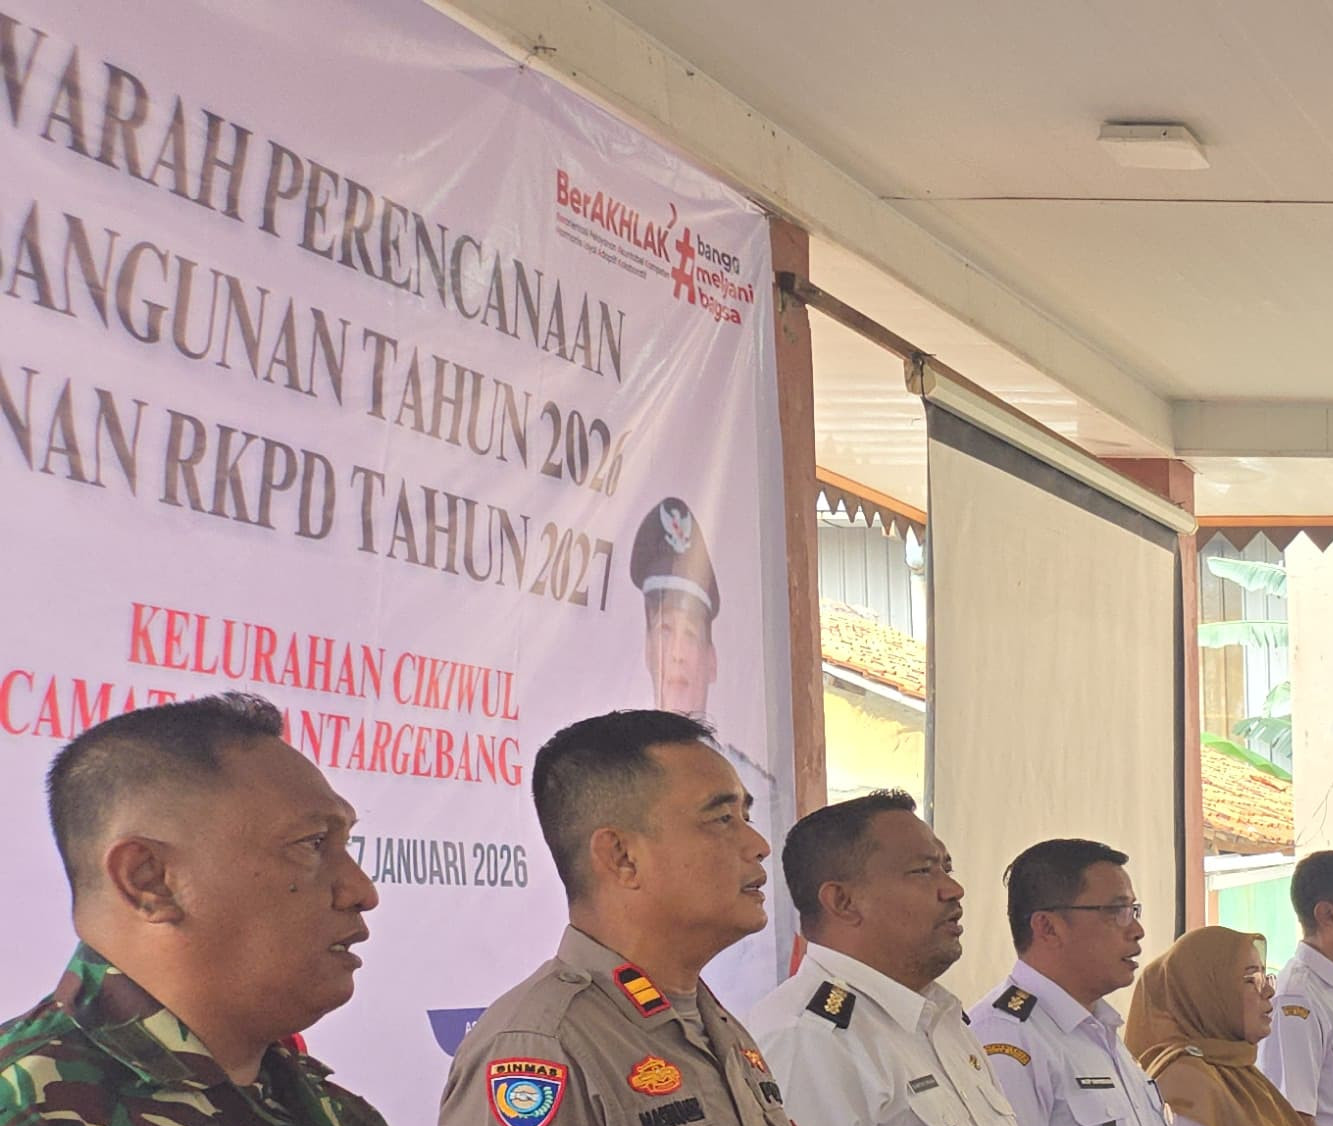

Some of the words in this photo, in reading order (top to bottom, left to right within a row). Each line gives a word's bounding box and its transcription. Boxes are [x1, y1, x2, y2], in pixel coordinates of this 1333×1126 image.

[258, 139, 626, 384] PERENCANAAN
[556, 169, 671, 263] BerAKHLAK
[0, 200, 352, 407] ANGUNAN
[363, 328, 533, 470] TAHUN
[540, 400, 632, 497] 2026
[159, 409, 337, 541] RKPD
[350, 465, 531, 591] TAHUN
[529, 521, 614, 612] 2027
[128, 602, 386, 700] KELURAHAN
[393, 652, 520, 721] CIKIWUL
[372, 837, 467, 886] JANUARI
[472, 842, 528, 889] 2026
